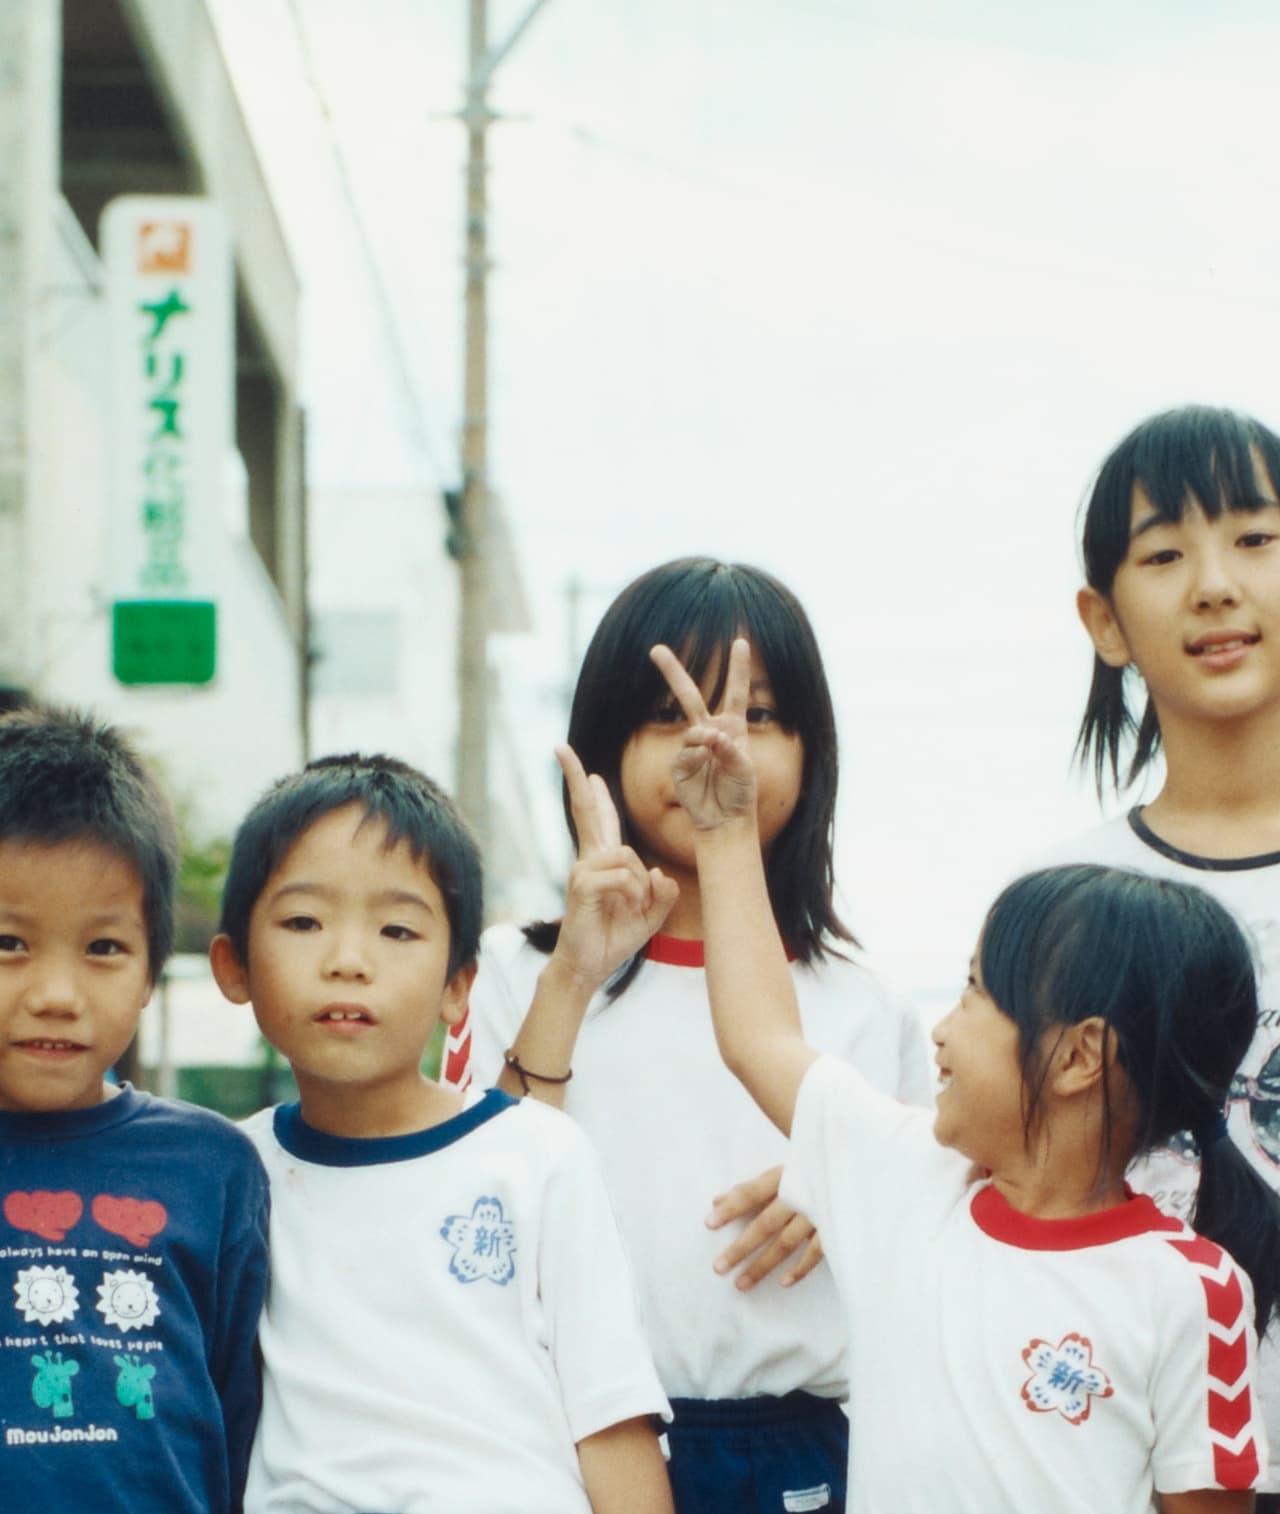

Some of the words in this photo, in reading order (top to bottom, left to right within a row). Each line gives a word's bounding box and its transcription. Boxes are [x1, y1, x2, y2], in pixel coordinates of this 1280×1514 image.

[0, 1246, 43, 1259] always
[47, 1246, 77, 1257] have
[82, 1248, 98, 1258] an
[102, 1250, 130, 1262] open
[133, 1253, 162, 1266] mind
[4, 1336, 48, 1348] heart
[54, 1333, 85, 1345] that
